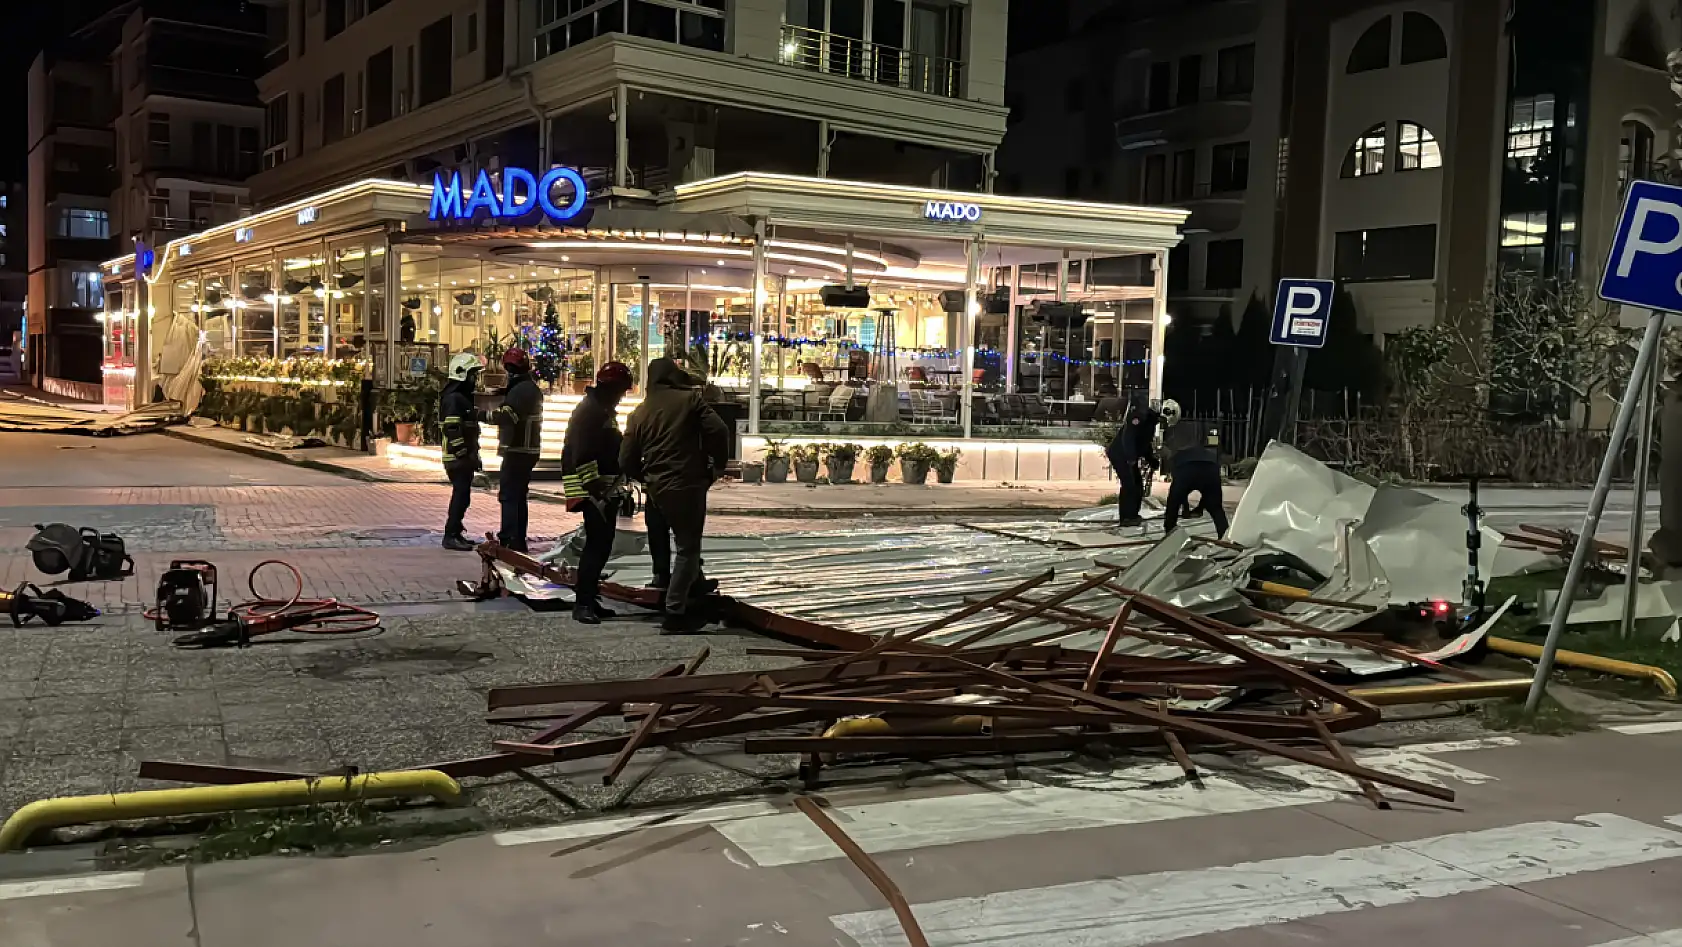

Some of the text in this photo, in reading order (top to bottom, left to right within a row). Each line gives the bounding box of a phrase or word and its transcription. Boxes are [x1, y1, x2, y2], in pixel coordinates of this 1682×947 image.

[428, 166, 587, 221] MADO
[925, 200, 981, 221] MADO
[1616, 197, 1682, 278] P
[1281, 286, 1321, 339] P
